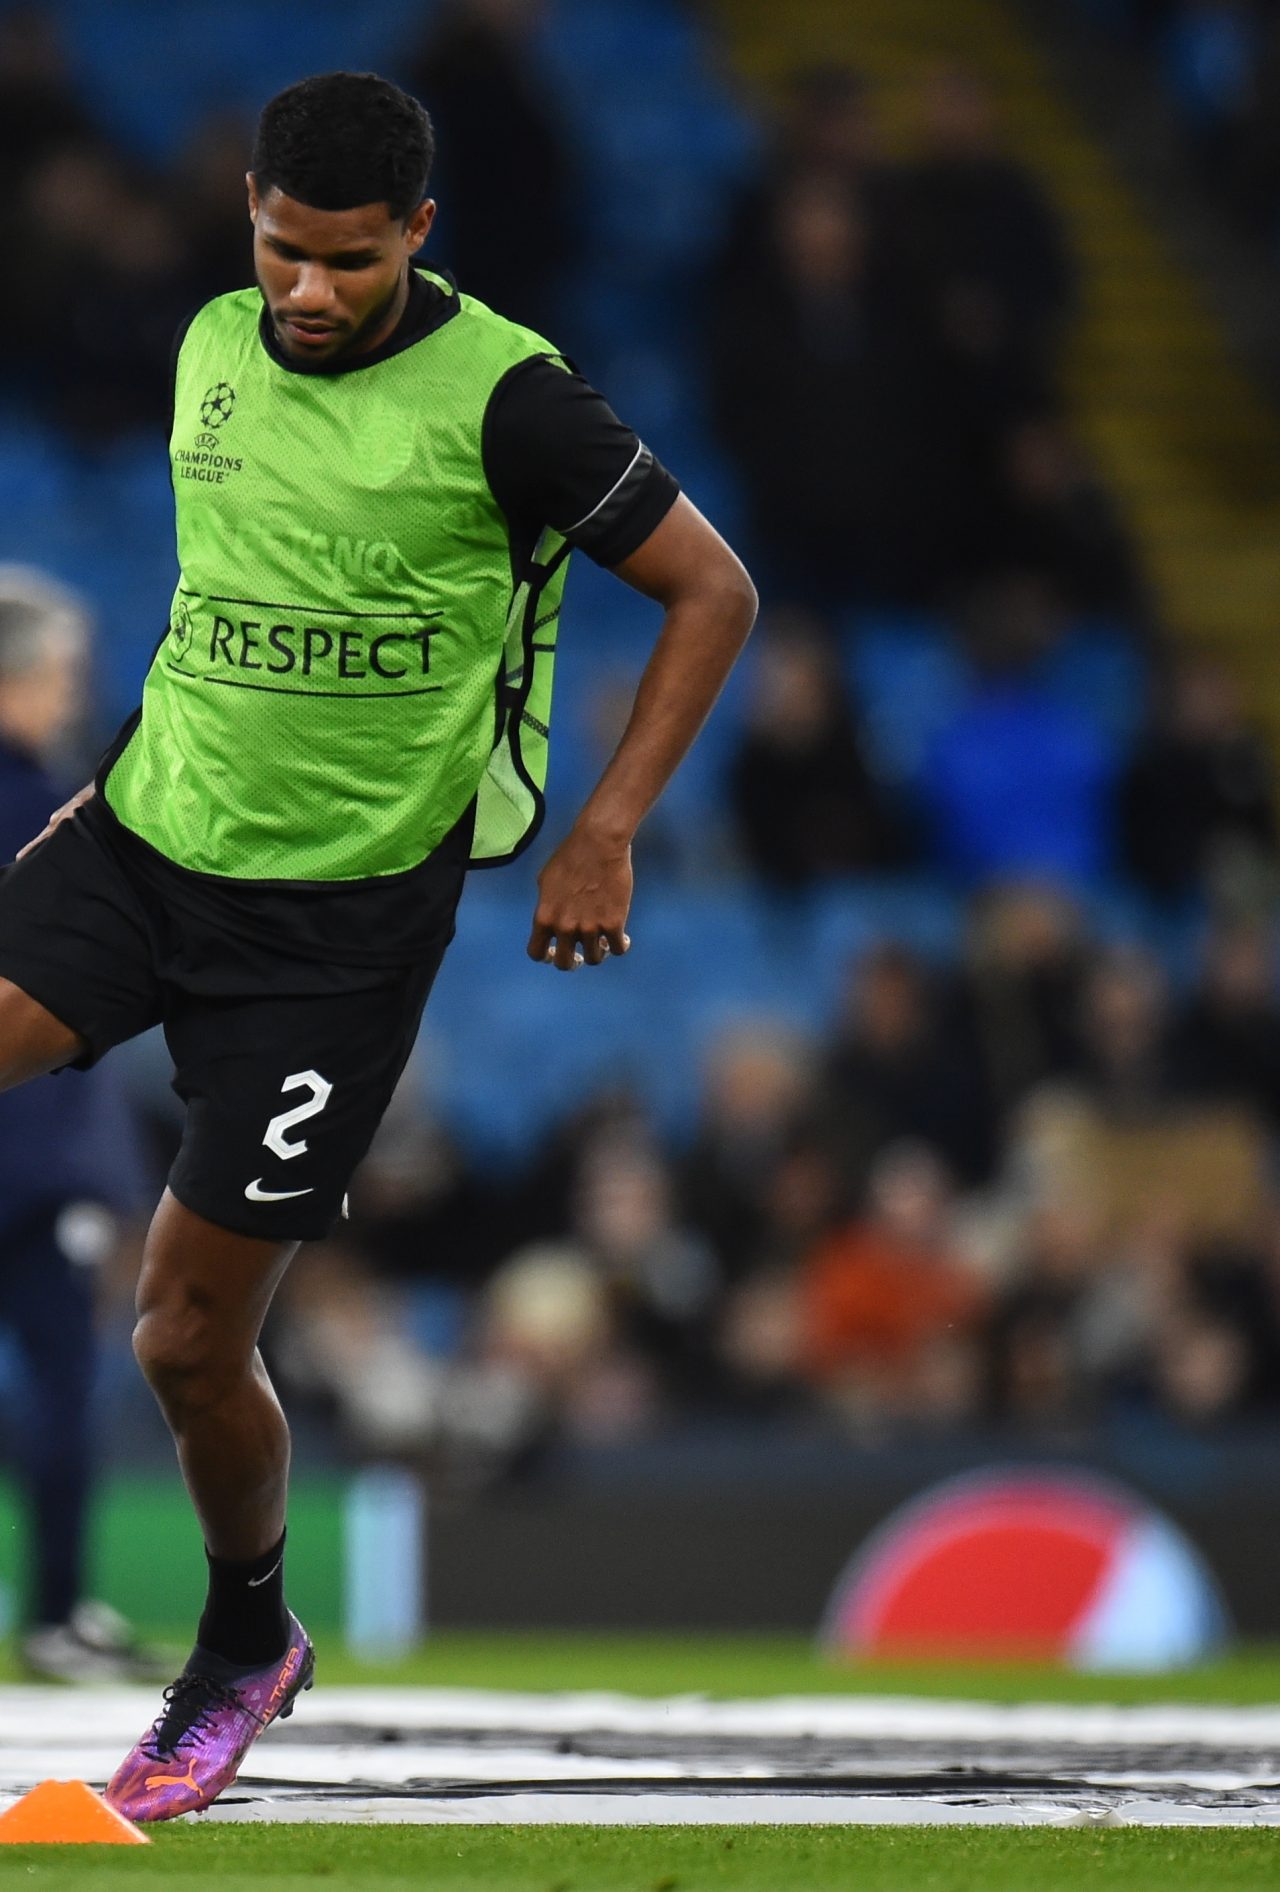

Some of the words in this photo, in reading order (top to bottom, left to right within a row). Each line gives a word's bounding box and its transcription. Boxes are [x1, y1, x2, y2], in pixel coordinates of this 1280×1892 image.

[195, 434, 218, 450] UEFA
[174, 449, 243, 471] CHAMPIONS
[180, 466, 225, 484] LEAGUE
[209, 616, 440, 679] RESPECT
[262, 1069, 333, 1160] 2
